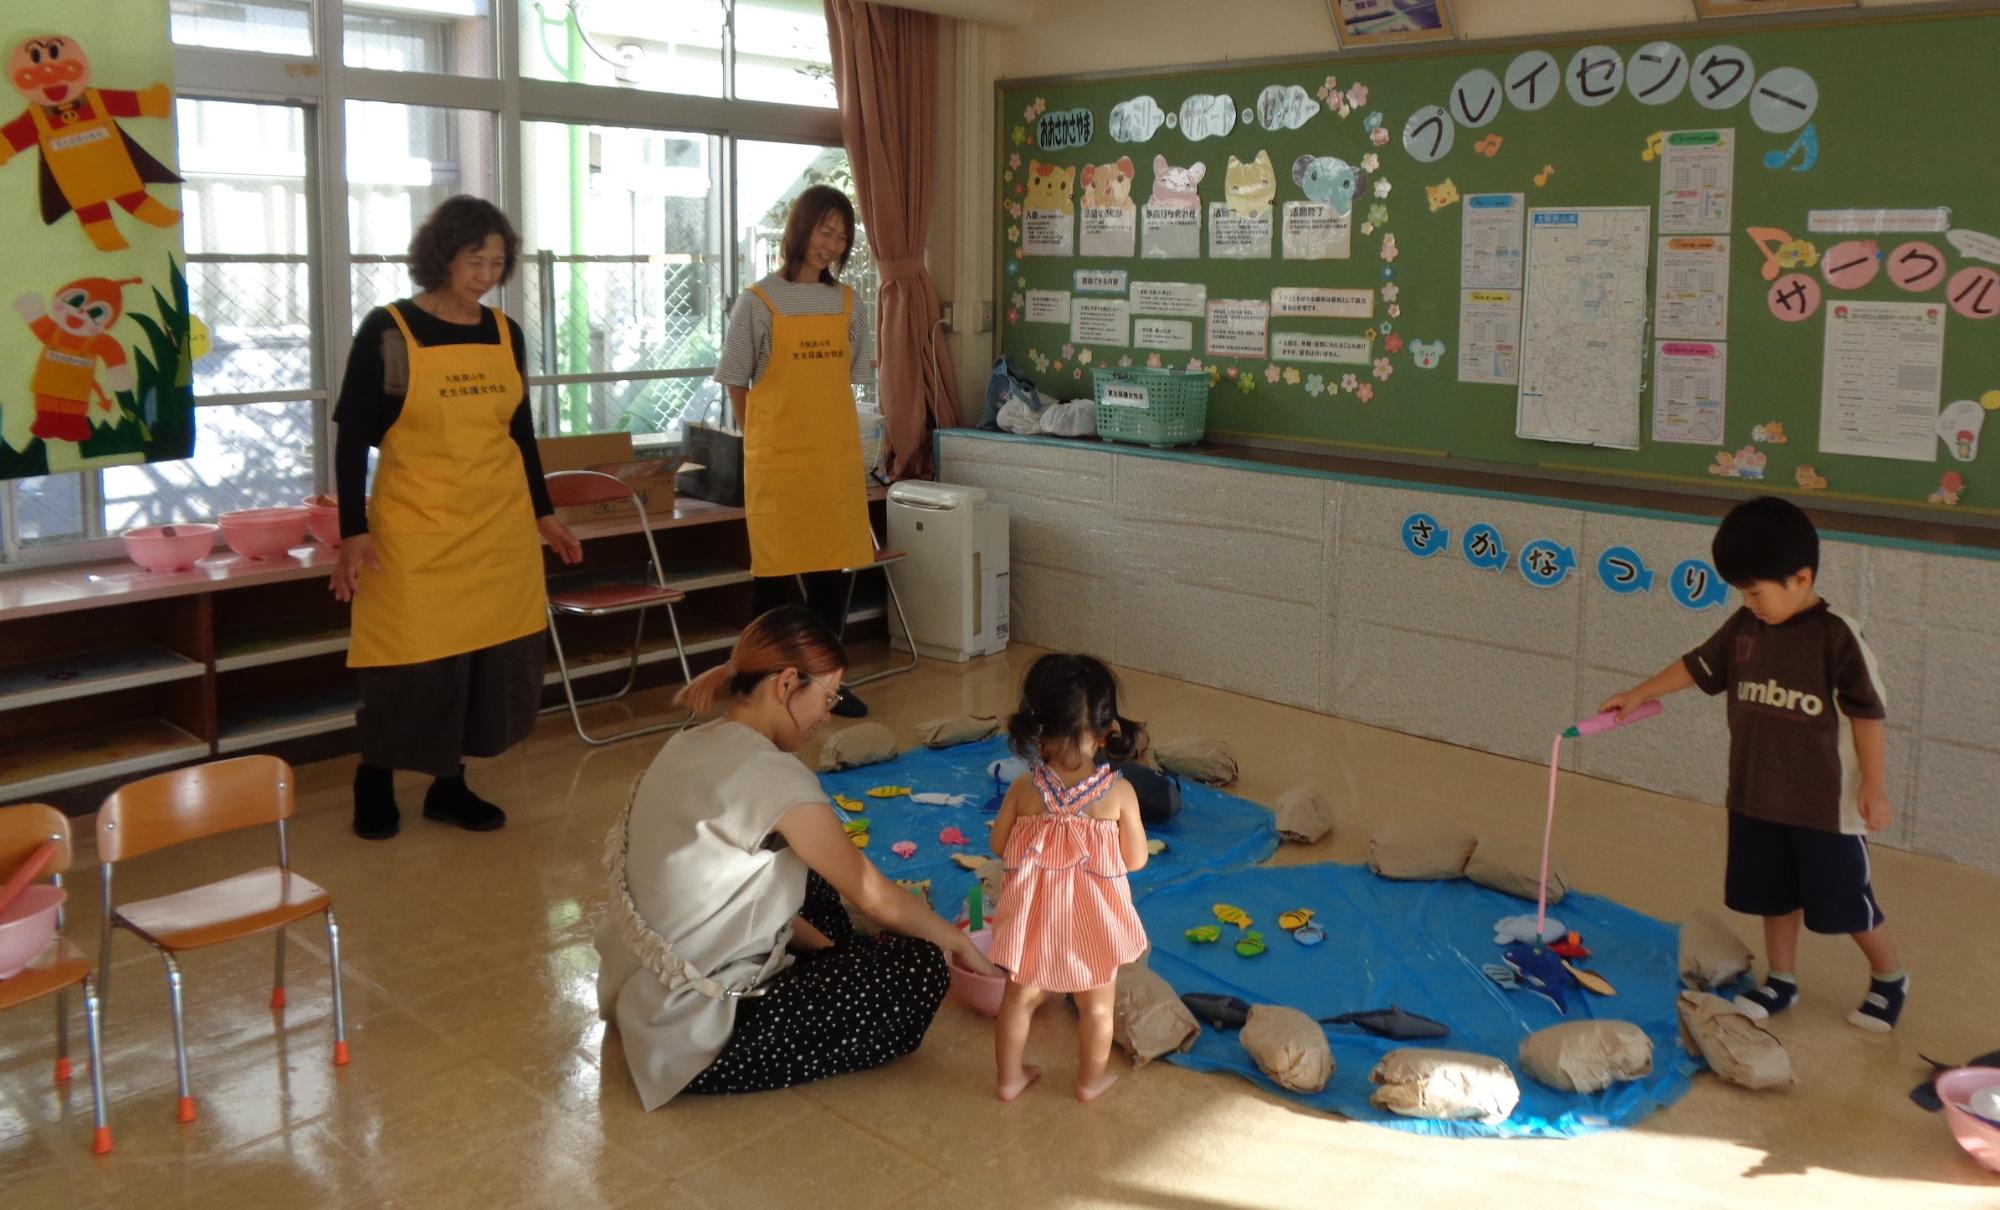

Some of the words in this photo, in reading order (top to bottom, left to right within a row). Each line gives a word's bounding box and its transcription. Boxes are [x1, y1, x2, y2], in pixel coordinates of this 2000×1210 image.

[1040, 111, 1091, 148] おおさかさやま
[1411, 54, 1807, 157] プレイセンター
[1776, 249, 1994, 314] サークル
[1411, 519, 1705, 599] さかなつり
[1737, 678, 1824, 717] umbro
